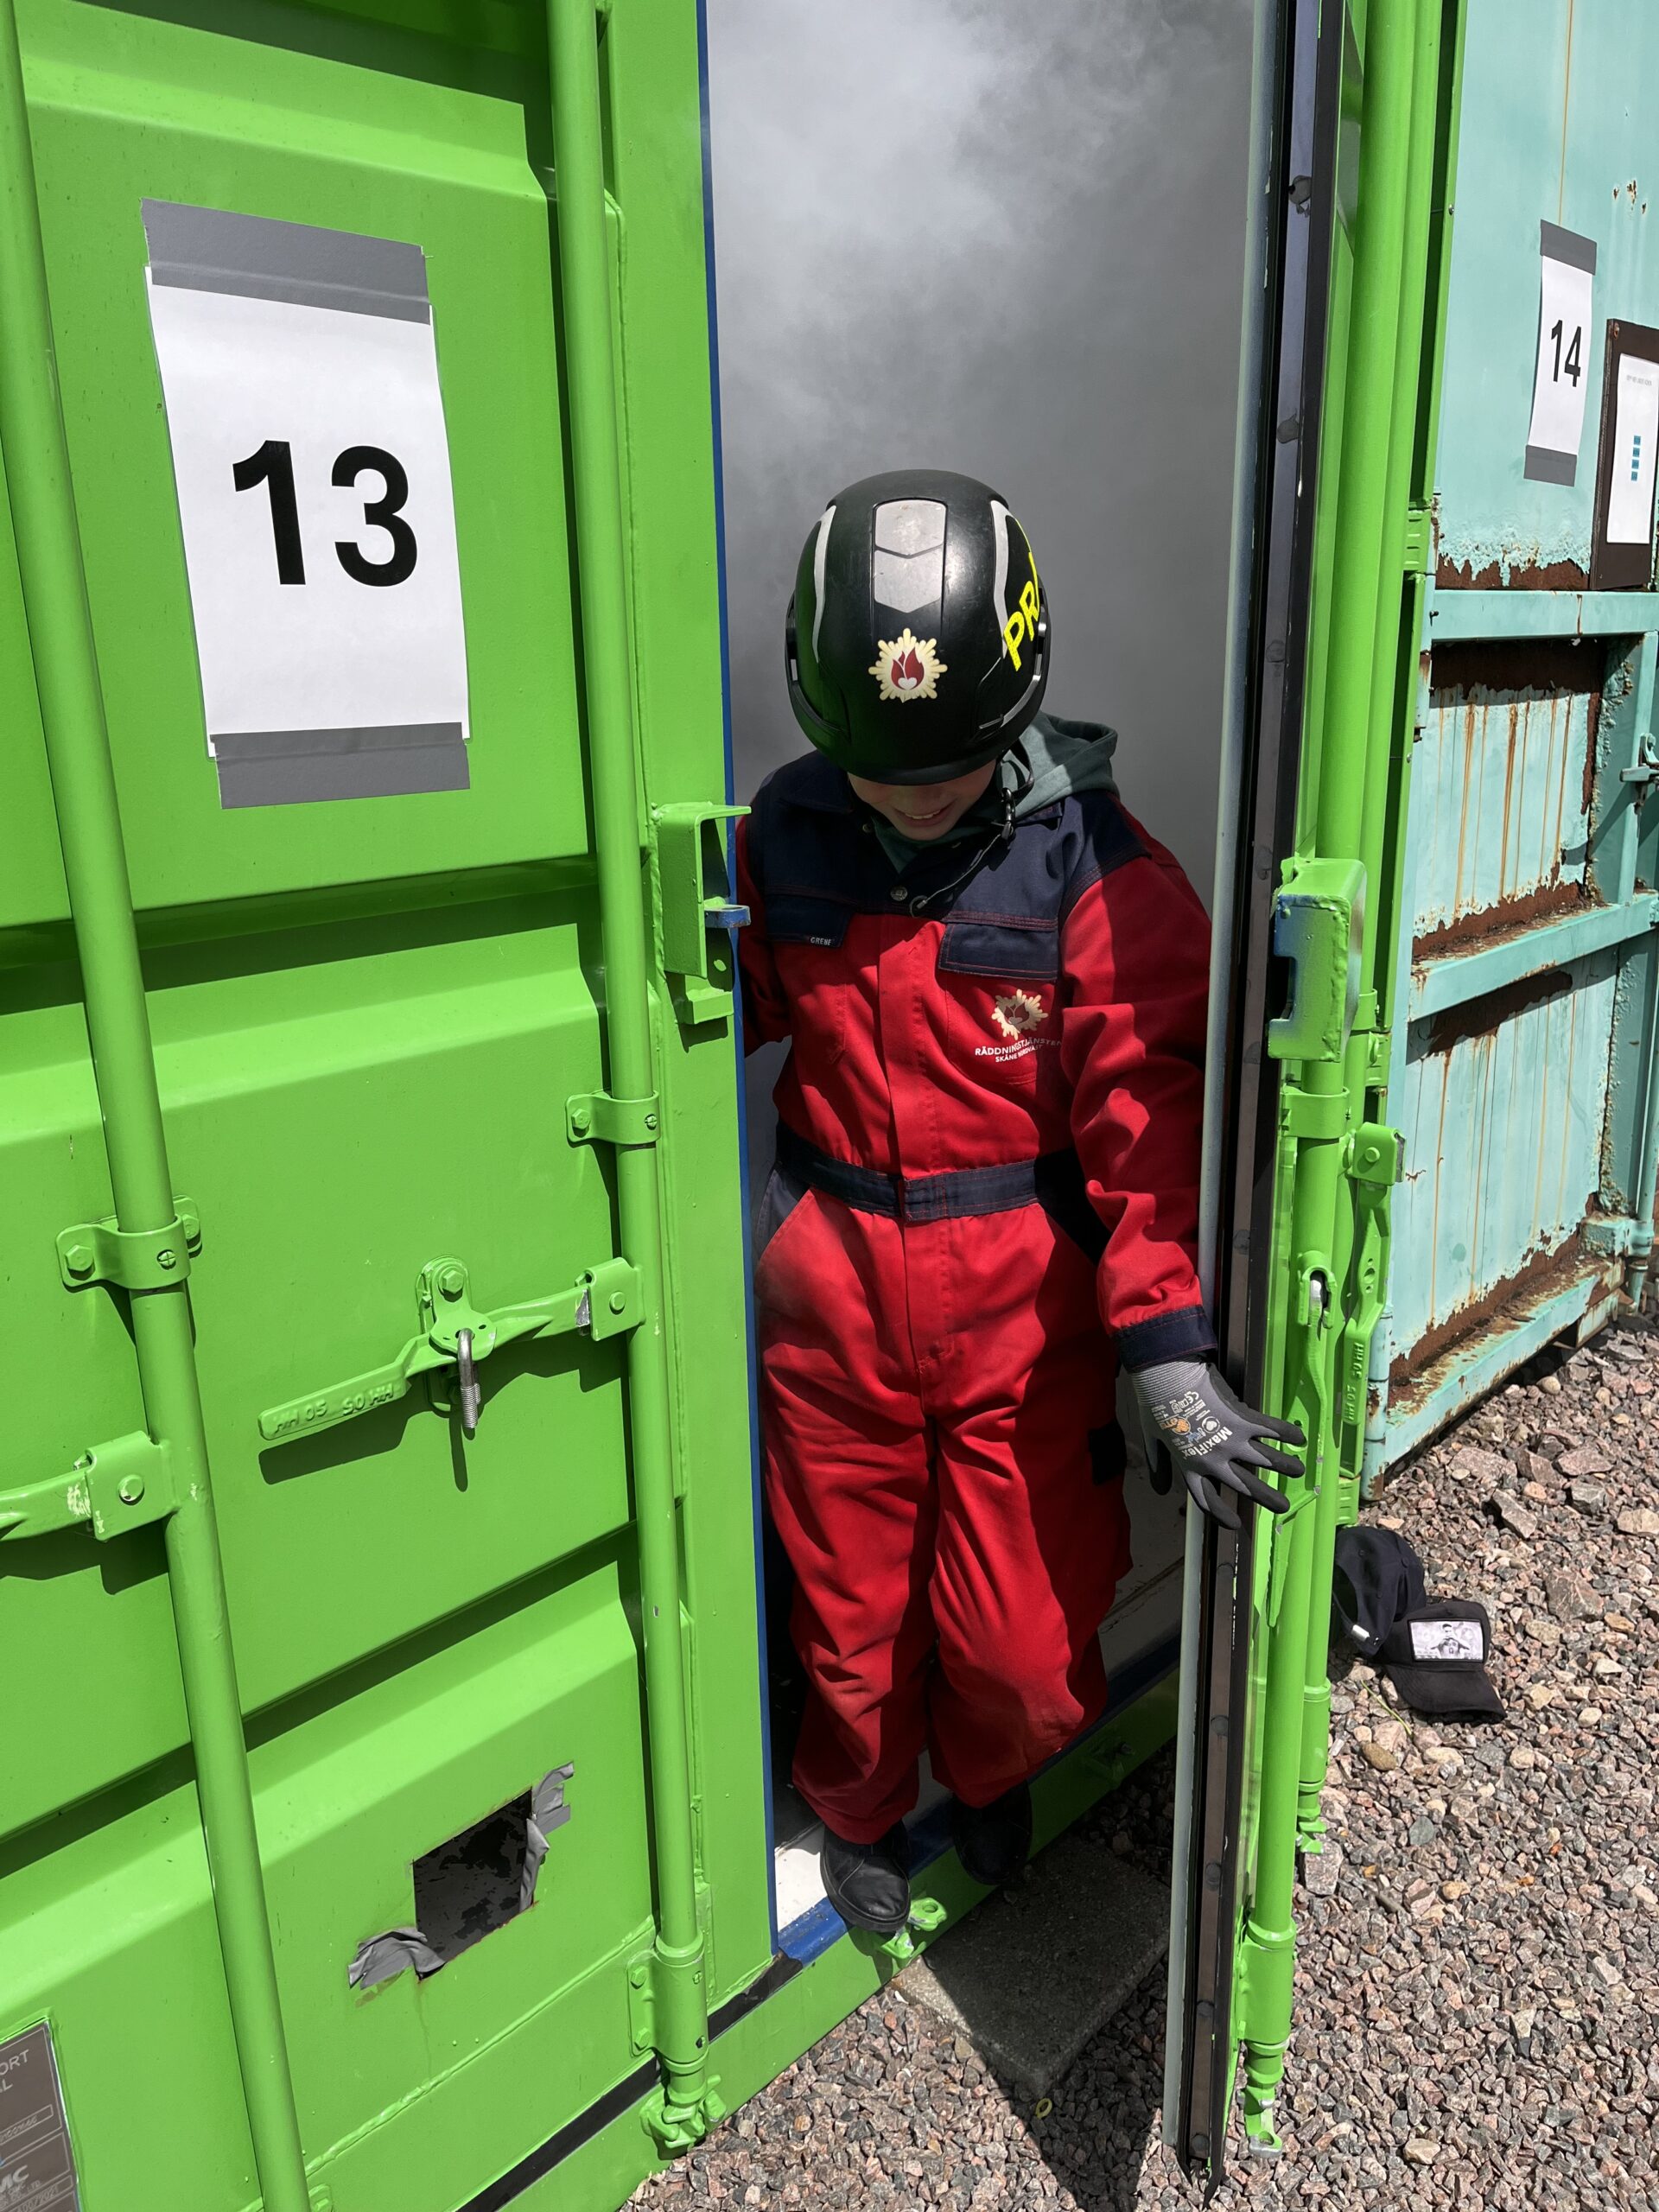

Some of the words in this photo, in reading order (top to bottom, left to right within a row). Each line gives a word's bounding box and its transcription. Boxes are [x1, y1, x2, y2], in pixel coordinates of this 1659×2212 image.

[1550, 319, 1582, 388] 14
[232, 439, 418, 588] 13
[995, 1053, 1018, 1063] SKÅNE
[1182, 1427, 1233, 1457] MaxiFlex
